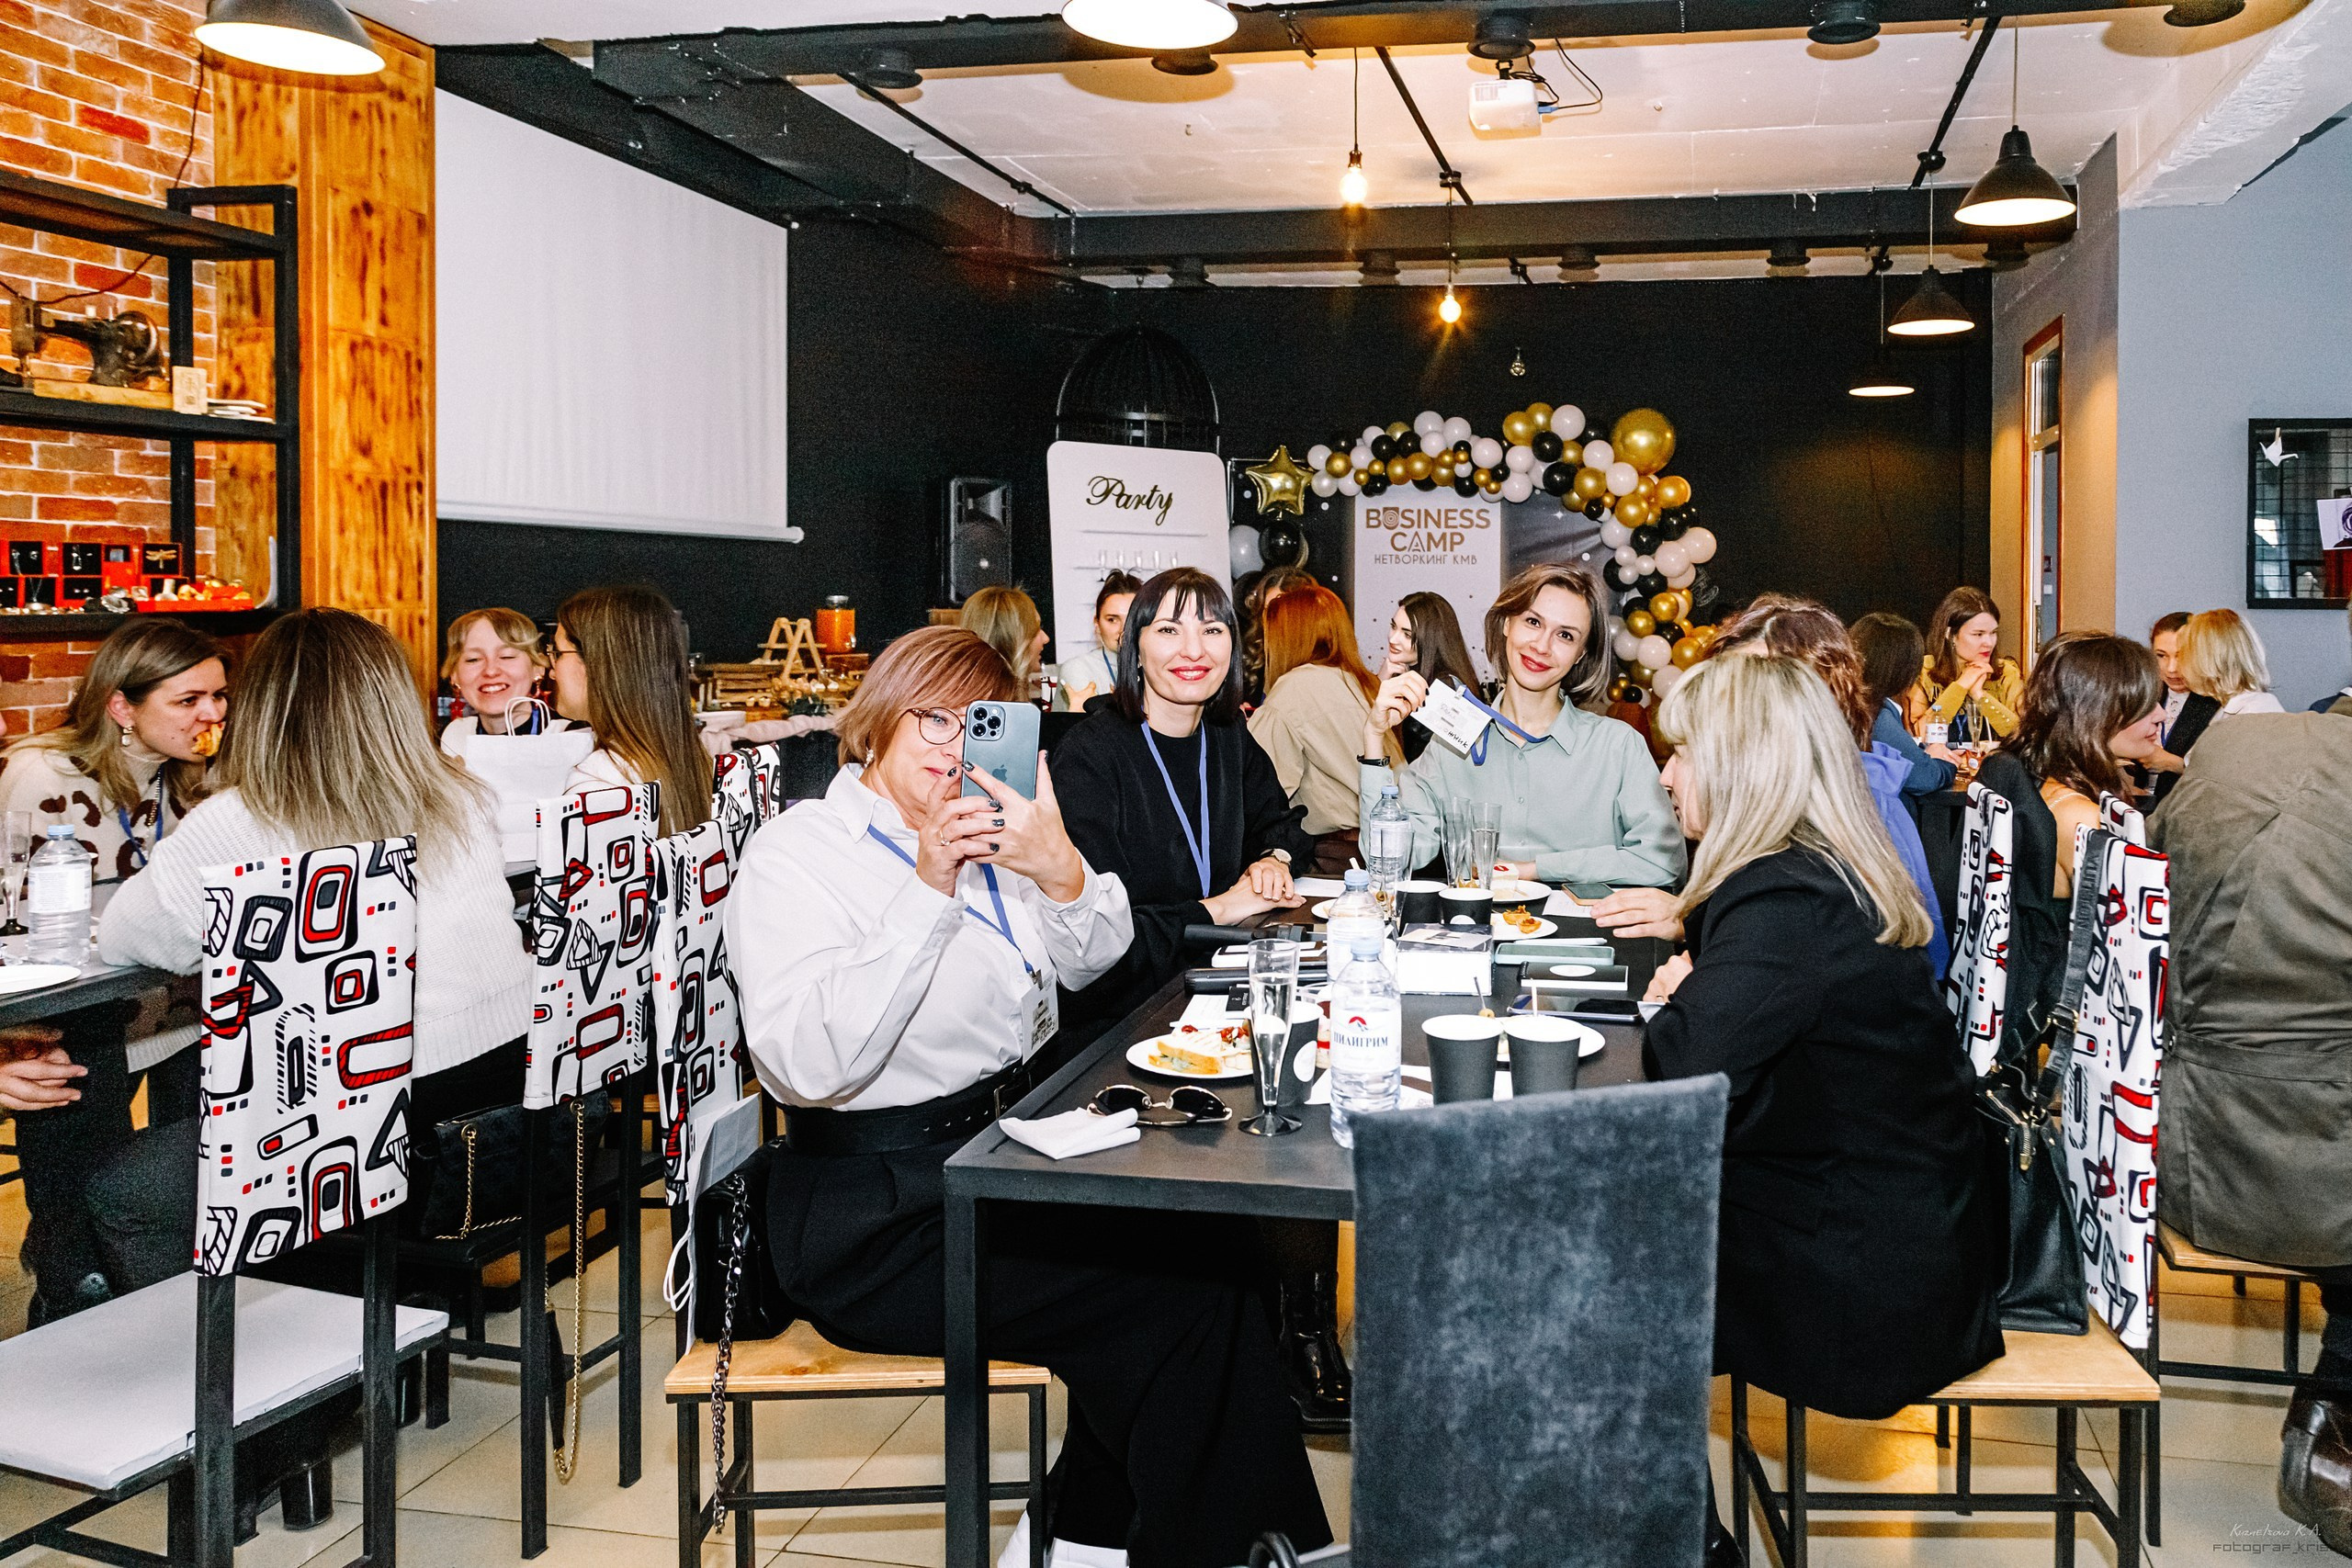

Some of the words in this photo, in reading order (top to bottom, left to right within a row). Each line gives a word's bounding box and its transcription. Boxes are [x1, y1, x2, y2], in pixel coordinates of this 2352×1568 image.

[1086, 475, 1173, 526] Party
[1365, 506, 1491, 530] BUSINESS
[1390, 531, 1465, 552] CAMP
[1374, 554, 1448, 565] НЕТВОРКИНГ
[1453, 554, 1477, 565] КМВ
